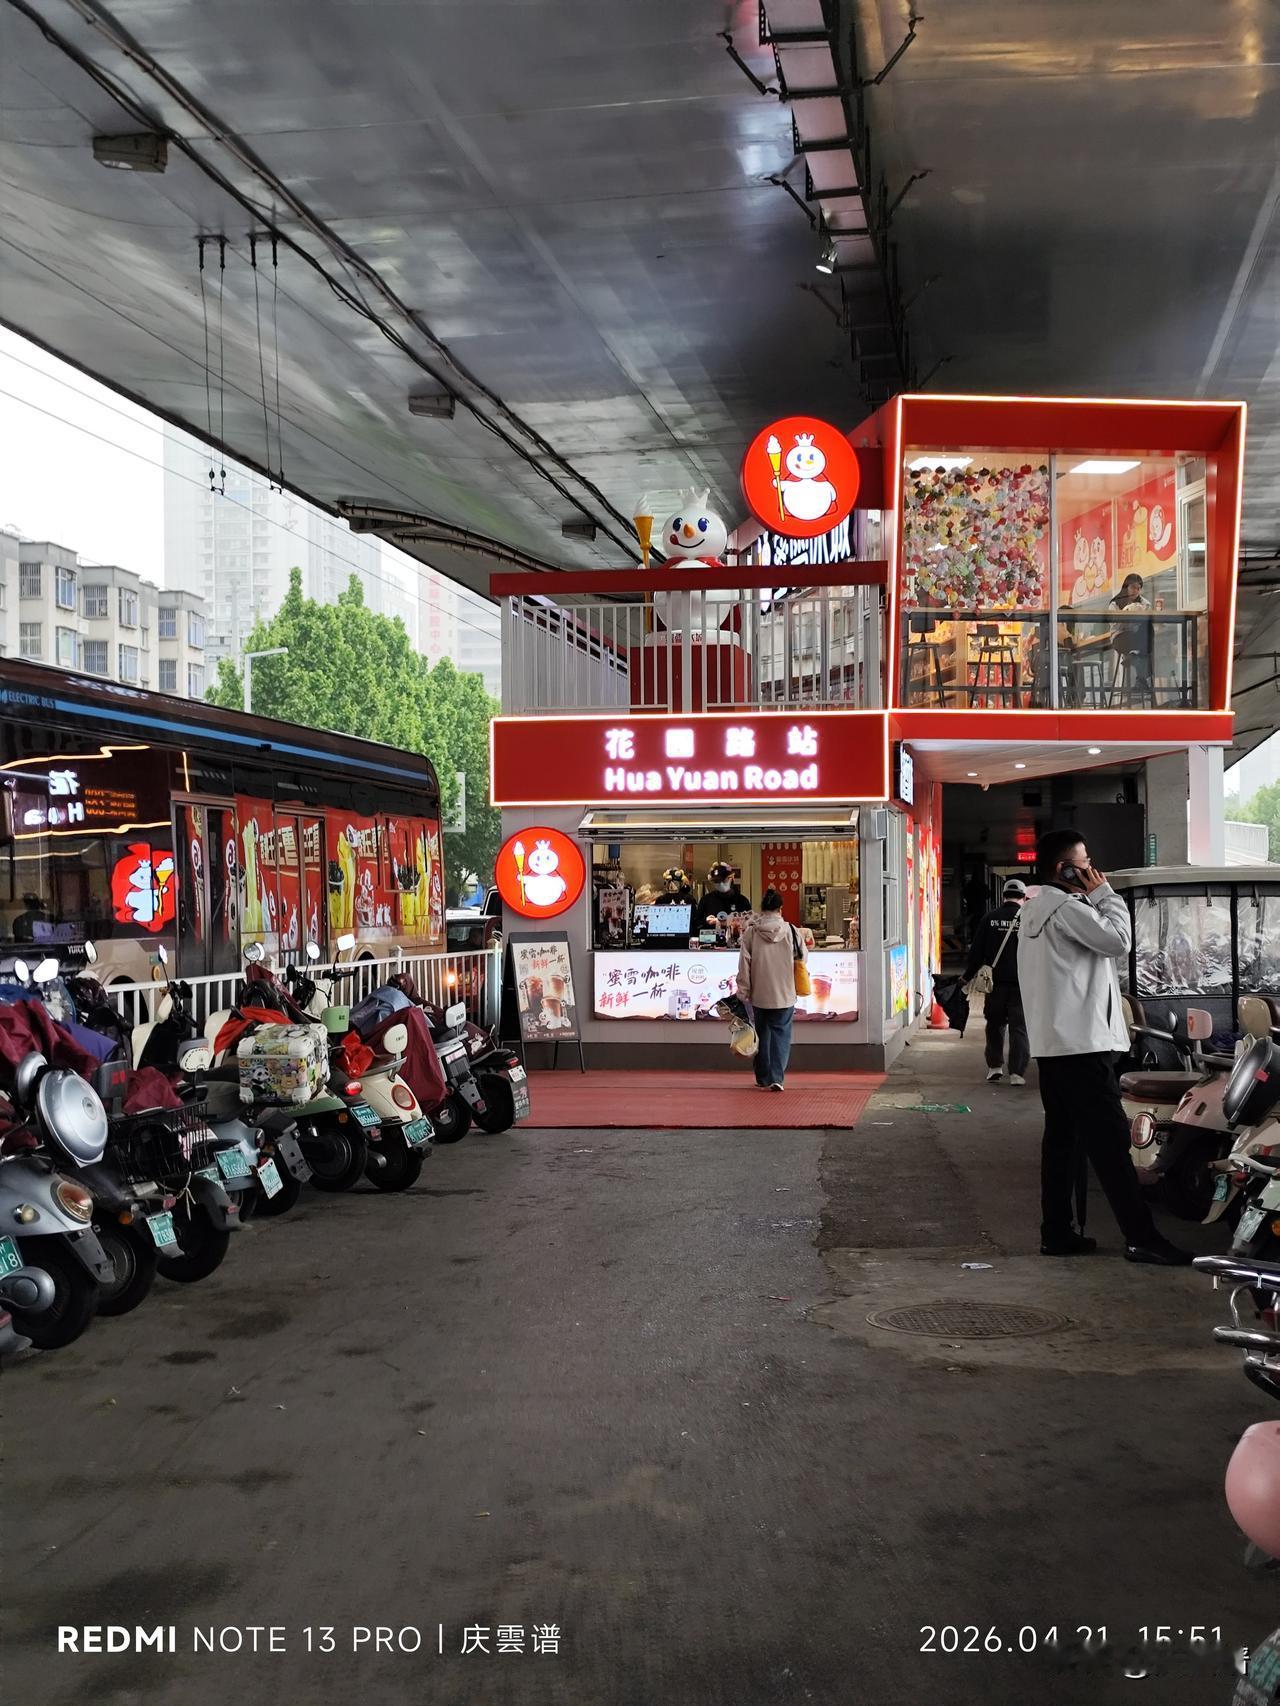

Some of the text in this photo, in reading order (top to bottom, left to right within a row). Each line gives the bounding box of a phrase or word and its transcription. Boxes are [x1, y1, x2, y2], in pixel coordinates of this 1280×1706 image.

[605, 763, 818, 791] Hua Yuan Road
[990, 919, 1000, 927] 0%
[606, 962, 681, 988] 蜜雪咖啡
[599, 982, 667, 1009] 新鲜一杯
